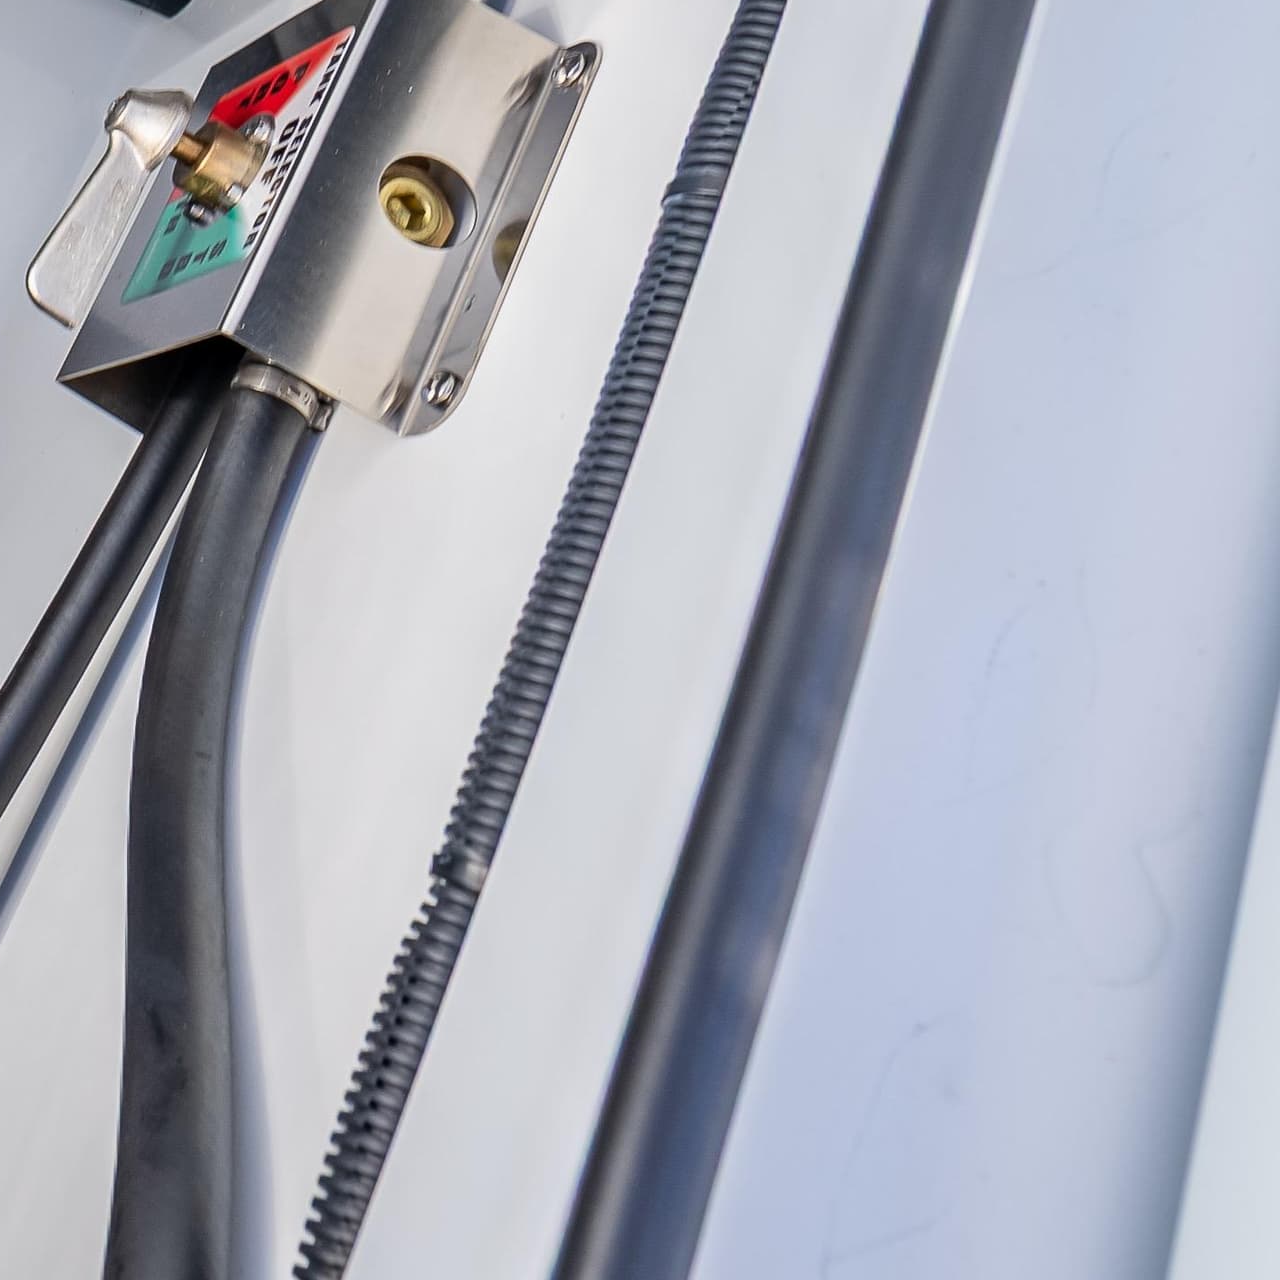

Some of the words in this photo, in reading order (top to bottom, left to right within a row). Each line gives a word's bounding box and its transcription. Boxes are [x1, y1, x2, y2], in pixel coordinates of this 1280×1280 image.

[309, 35, 352, 108] TANK
[242, 113, 313, 250] SELECTOR
[260, 118, 300, 187] OFF
